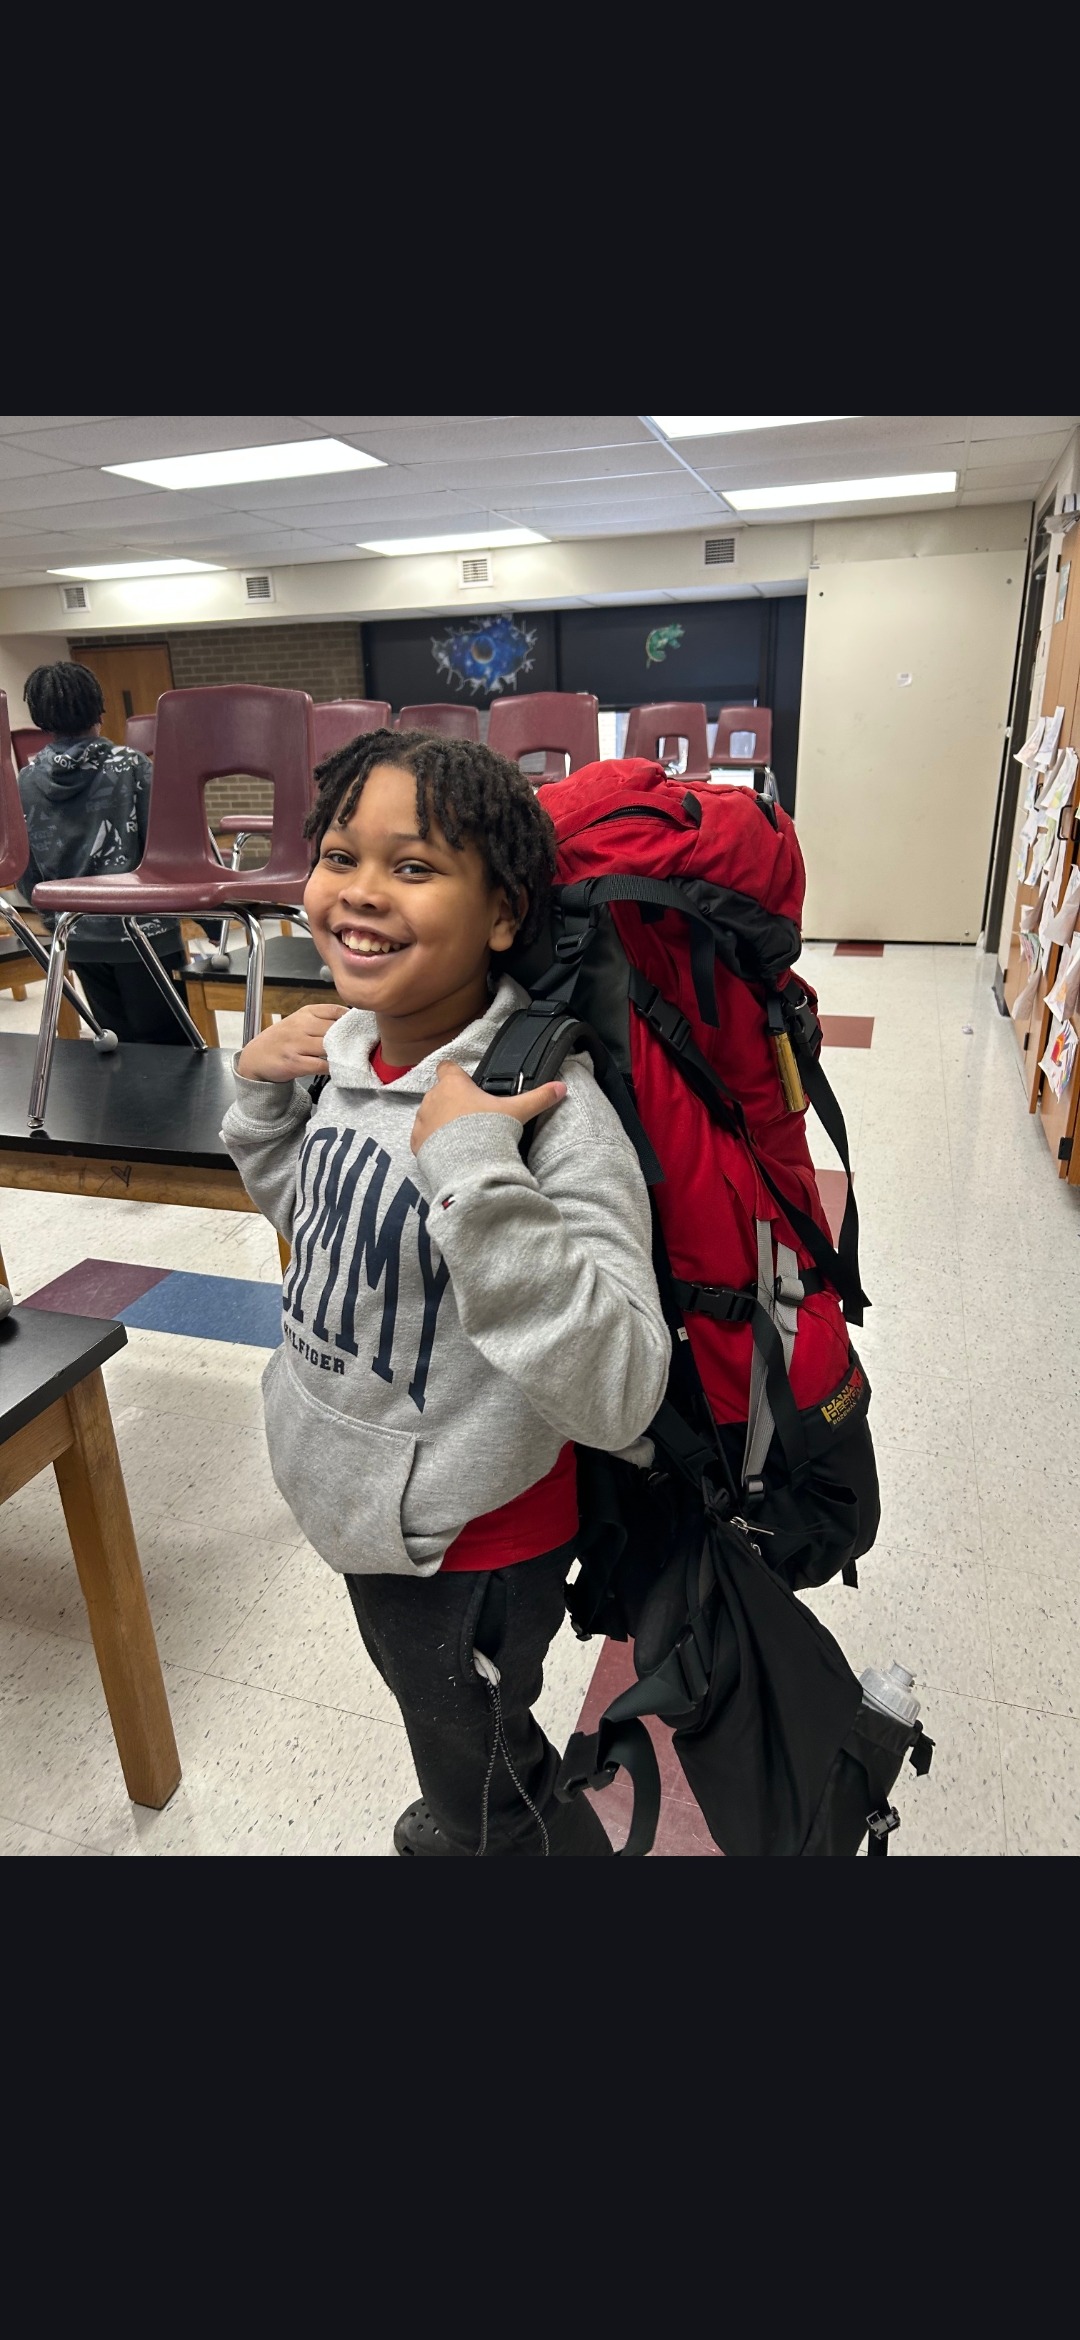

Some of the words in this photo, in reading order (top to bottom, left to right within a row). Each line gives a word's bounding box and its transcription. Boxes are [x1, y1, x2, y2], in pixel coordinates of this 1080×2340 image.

[283, 1127, 450, 1414] OMMY
[825, 1384, 856, 1412] DANA
[829, 1386, 862, 1420] DESIGN
